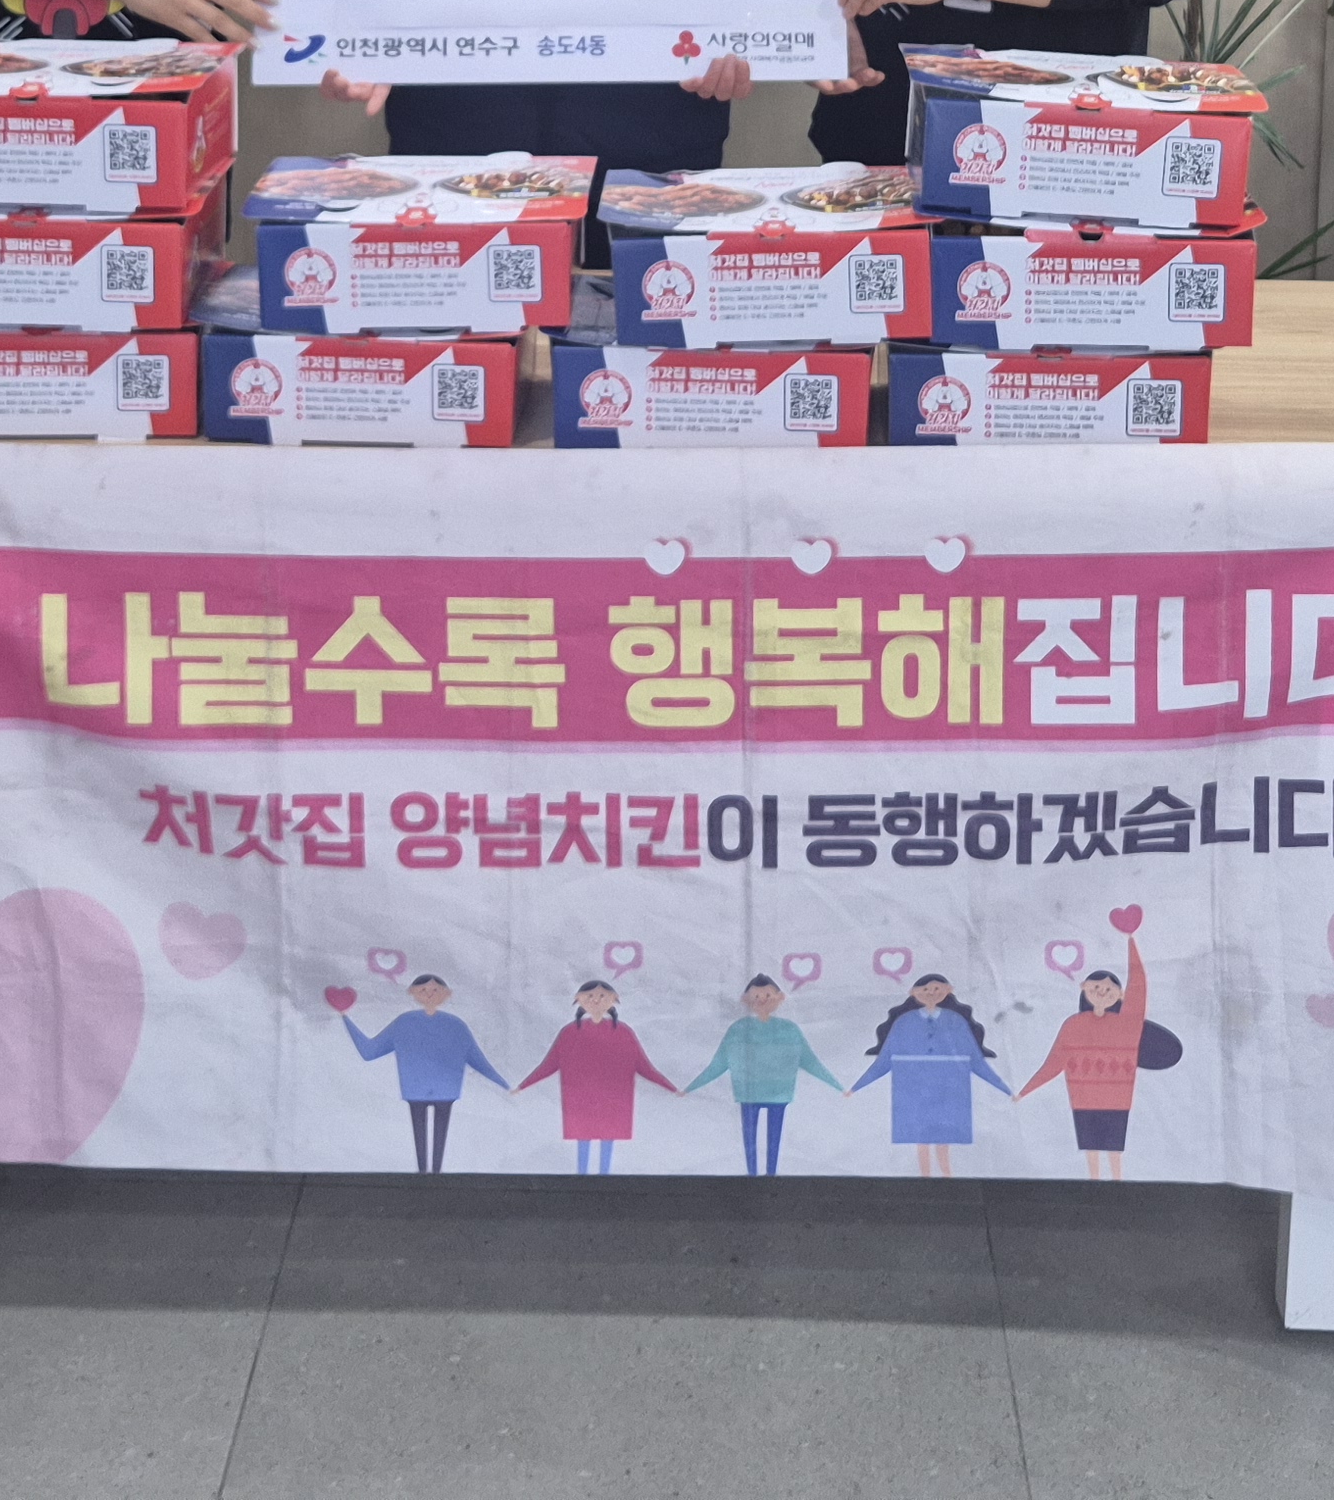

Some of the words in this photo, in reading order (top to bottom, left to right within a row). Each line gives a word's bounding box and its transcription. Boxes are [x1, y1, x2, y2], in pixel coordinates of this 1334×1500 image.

[336, 36, 449, 59] 인천광역시
[455, 35, 520, 58] 연수구
[537, 35, 607, 57] 송도4동
[707, 31, 815, 54] 사랑의열매
[40, 591, 566, 729] 나눌수록
[138, 783, 367, 869] 처갓집
[389, 790, 779, 870] 양념치킨이
